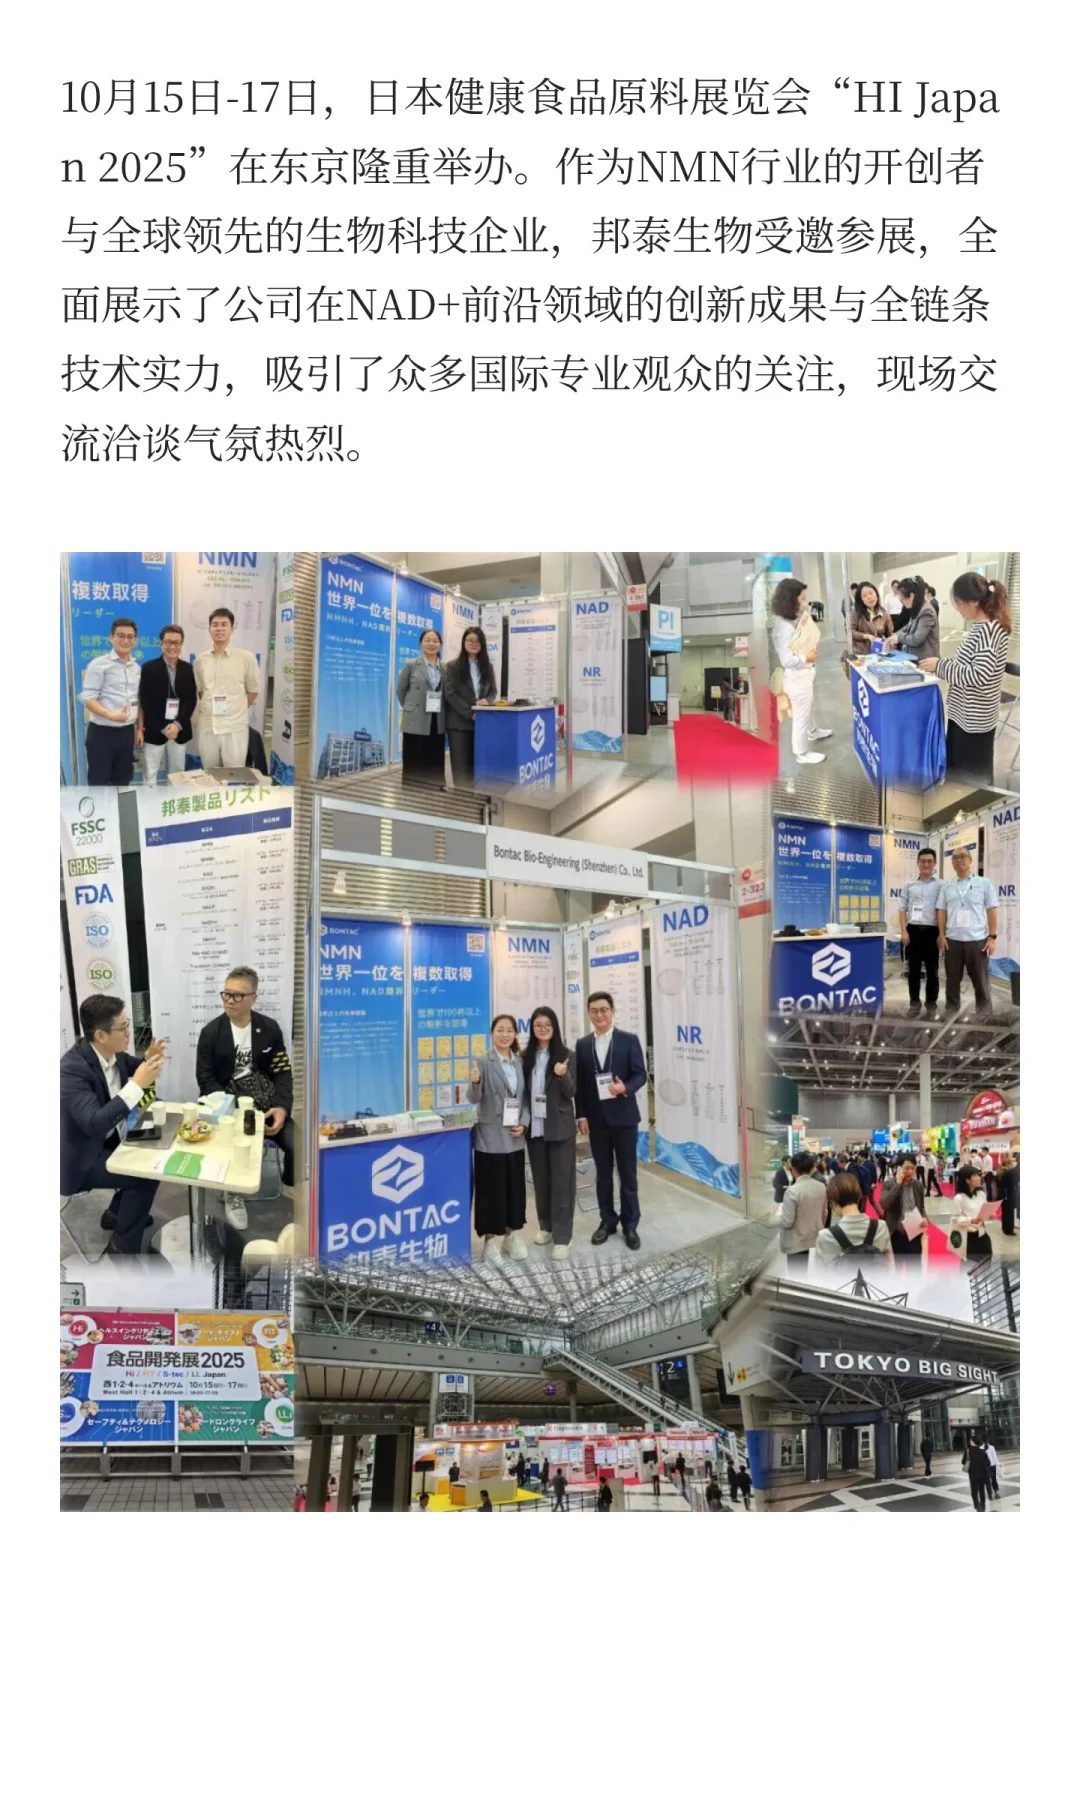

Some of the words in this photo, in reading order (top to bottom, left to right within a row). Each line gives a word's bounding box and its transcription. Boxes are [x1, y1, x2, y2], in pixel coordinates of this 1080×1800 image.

[72, 580, 149, 603] 複数取得
[327, 571, 364, 595] NMN
[72, 608, 115, 618] リーダー
[327, 590, 392, 620] 世界一位を
[452, 603, 474, 620] NMN
[576, 601, 609, 615] NAD
[658, 610, 675, 630] PI
[583, 667, 602, 677] NR
[519, 752, 554, 785] BONTAC
[161, 786, 271, 817] 邦泰製品リスト
[71, 818, 106, 836] FSSC
[76, 833, 103, 846] 22000
[778, 834, 806, 846] NMN
[894, 838, 921, 850] NMN
[69, 858, 97, 876] GRAS
[493, 844, 522, 861] Bontac
[523, 849, 580, 873] Bio-Engineering
[581, 858, 617, 875] (Shenzhen)
[618, 864, 631, 877] Co.,
[632, 867, 645, 878] Ltd.
[75, 883, 114, 905] FDA
[998, 885, 1016, 896] NR
[662, 905, 709, 933] NAD
[86, 925, 109, 936] ISO
[329, 927, 358, 936] BONTAC
[507, 937, 551, 954] NMN
[90, 969, 112, 979] ISO
[320, 964, 404, 981] 世界一位を
[413, 966, 473, 982] 複数取得
[778, 986, 877, 1016] BONTAC
[676, 1025, 703, 1045] NR
[327, 1200, 460, 1253] BONTAC
[106, 1350, 246, 1369] 食品開発展2025
[667, 1361, 675, 1373] 2
[814, 1352, 910, 1372] TOKYO
[918, 1359, 951, 1376] BIG
[957, 1365, 998, 1383] SIGHT
[114, 1425, 143, 1434] ジャパン
[212, 1426, 240, 1434] ジャパン
